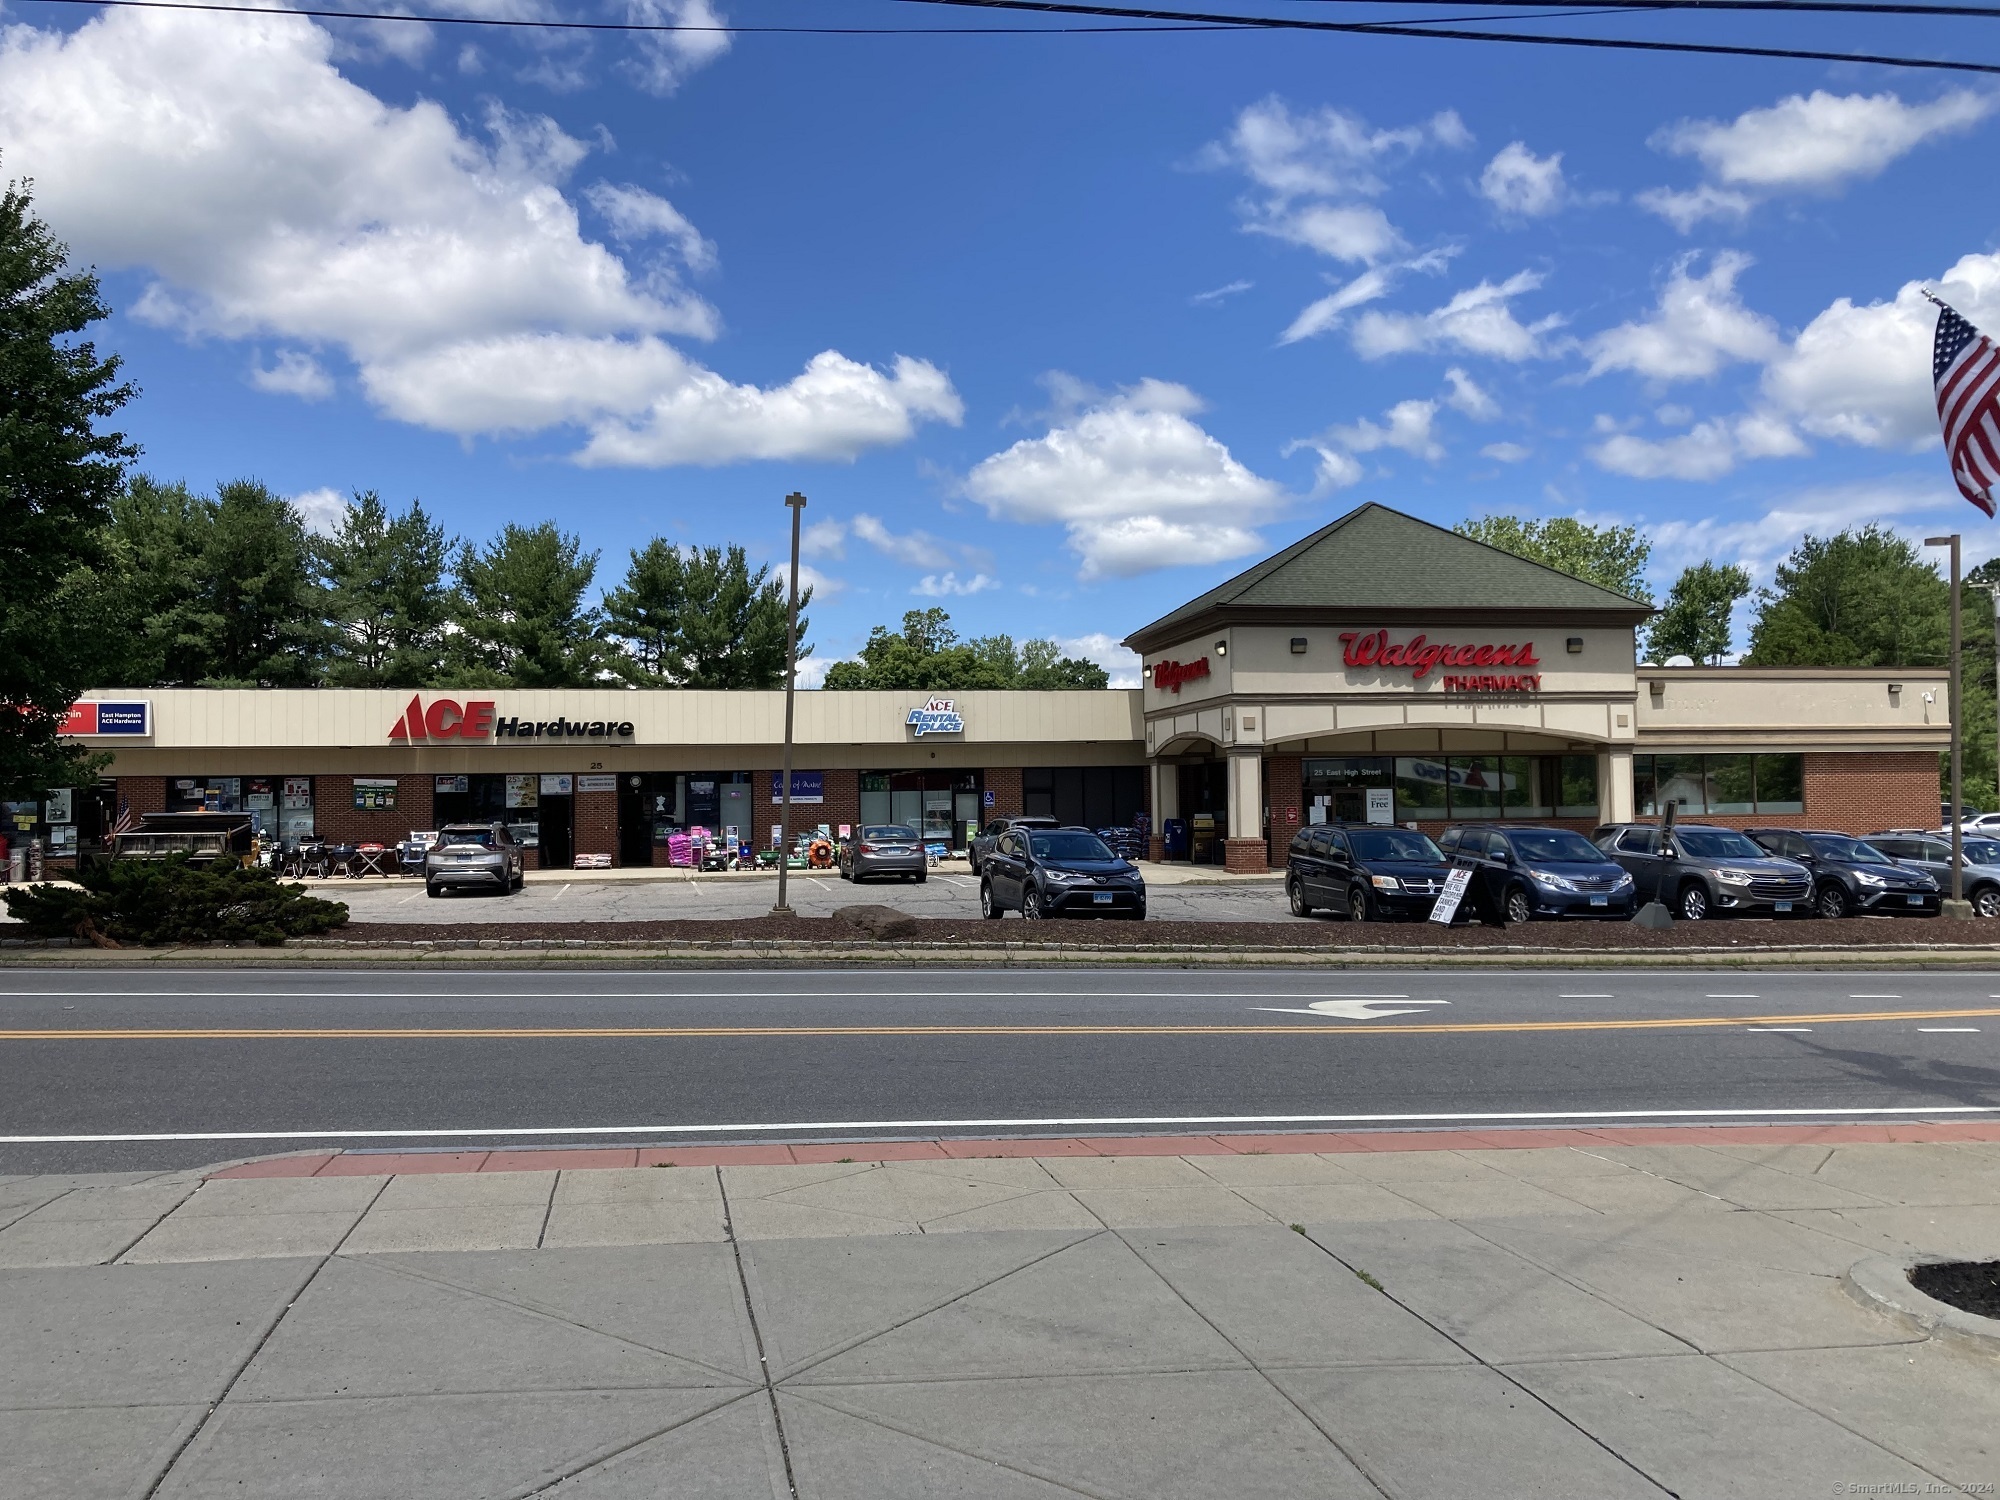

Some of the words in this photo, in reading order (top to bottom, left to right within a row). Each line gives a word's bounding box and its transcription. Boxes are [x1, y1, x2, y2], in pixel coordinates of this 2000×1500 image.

[1338, 629, 1540, 679] Walgreens
[1443, 674, 1542, 691] PHARMACY
[925, 701, 952, 711] ACE
[388, 693, 495, 738] ACE
[495, 717, 635, 737] Hardware
[908, 711, 959, 722] RENTAL
[917, 722, 962, 734] PLACE
[1344, 769, 1358, 777] High
